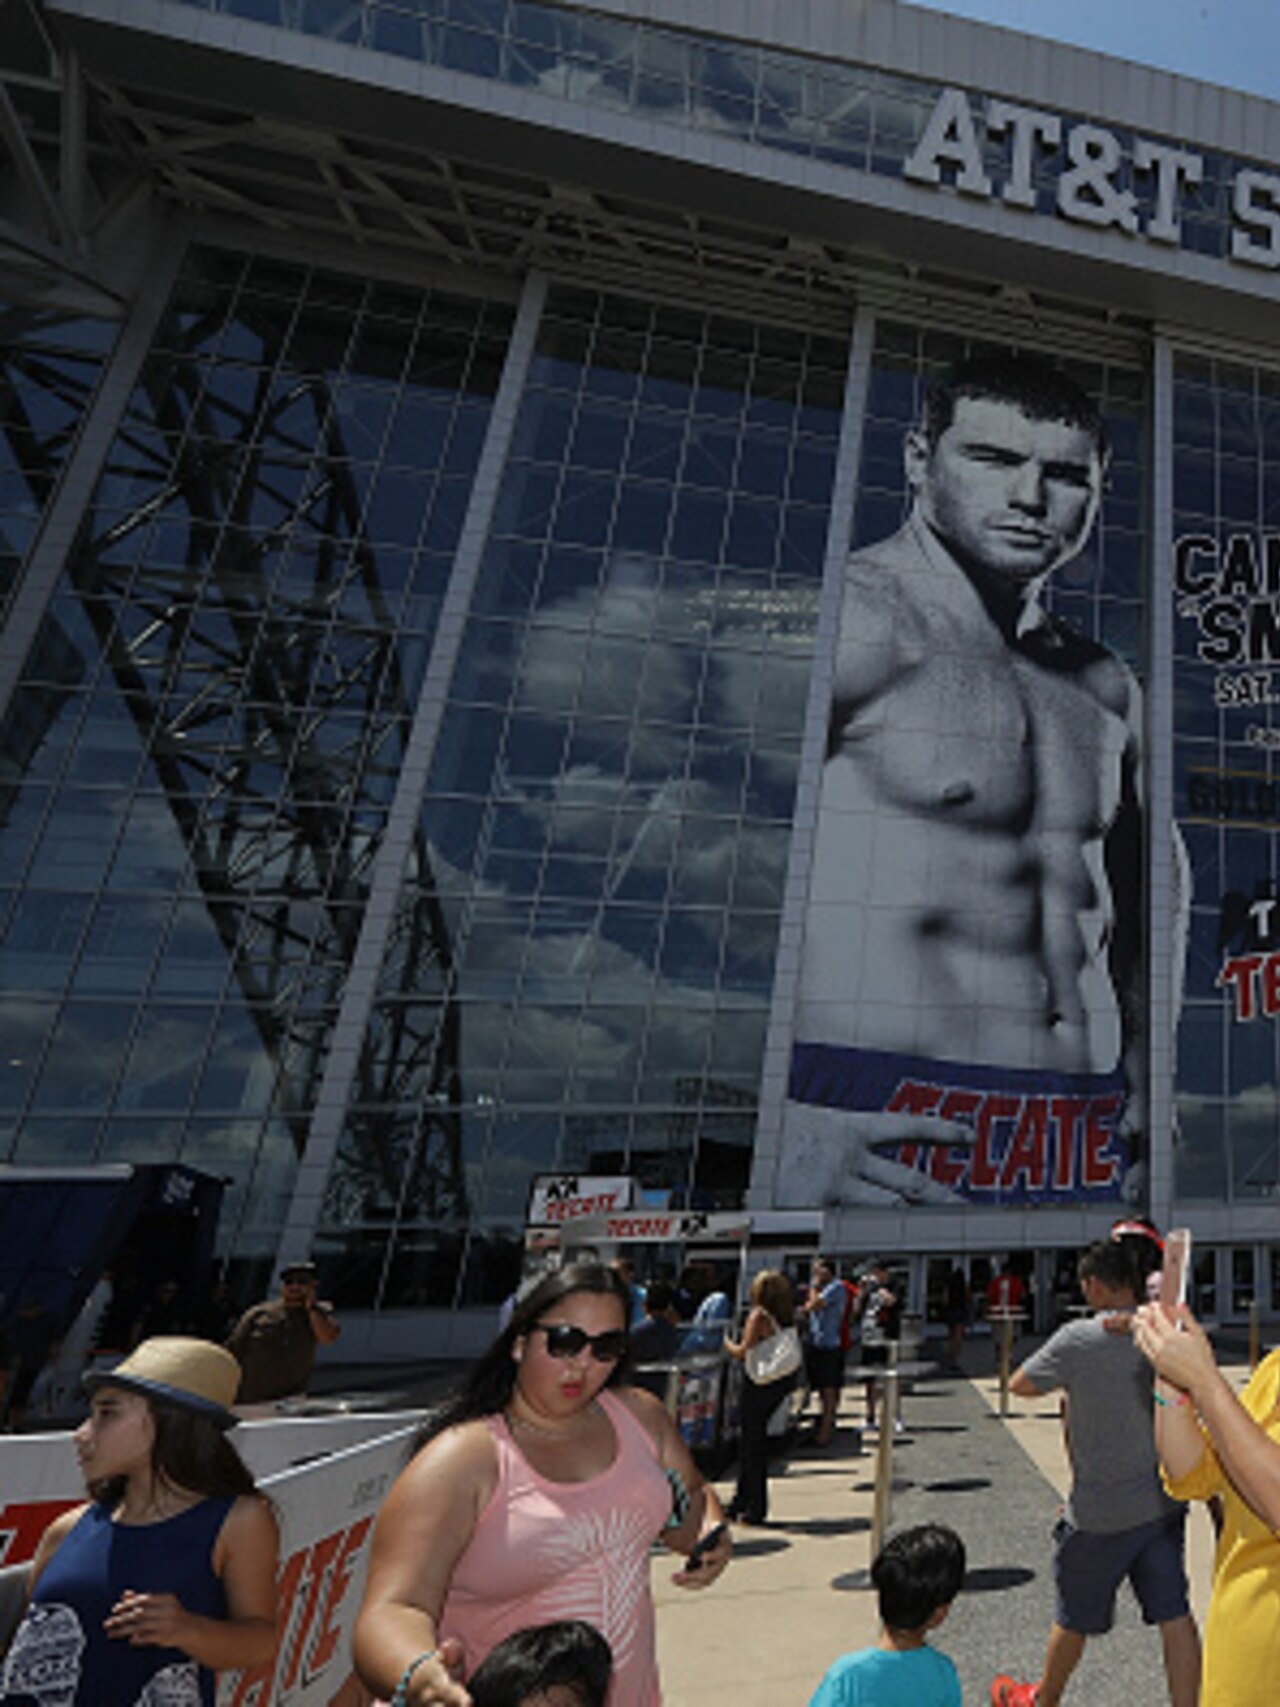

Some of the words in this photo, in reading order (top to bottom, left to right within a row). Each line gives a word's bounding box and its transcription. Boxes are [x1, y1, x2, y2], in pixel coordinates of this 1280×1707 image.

[902, 87, 1202, 246] AT&T
[1214, 671, 1280, 707] SAT.
[884, 1078, 1126, 1192] TECATE
[545, 1190, 621, 1222] TECATE
[605, 1216, 675, 1238] TECATE
